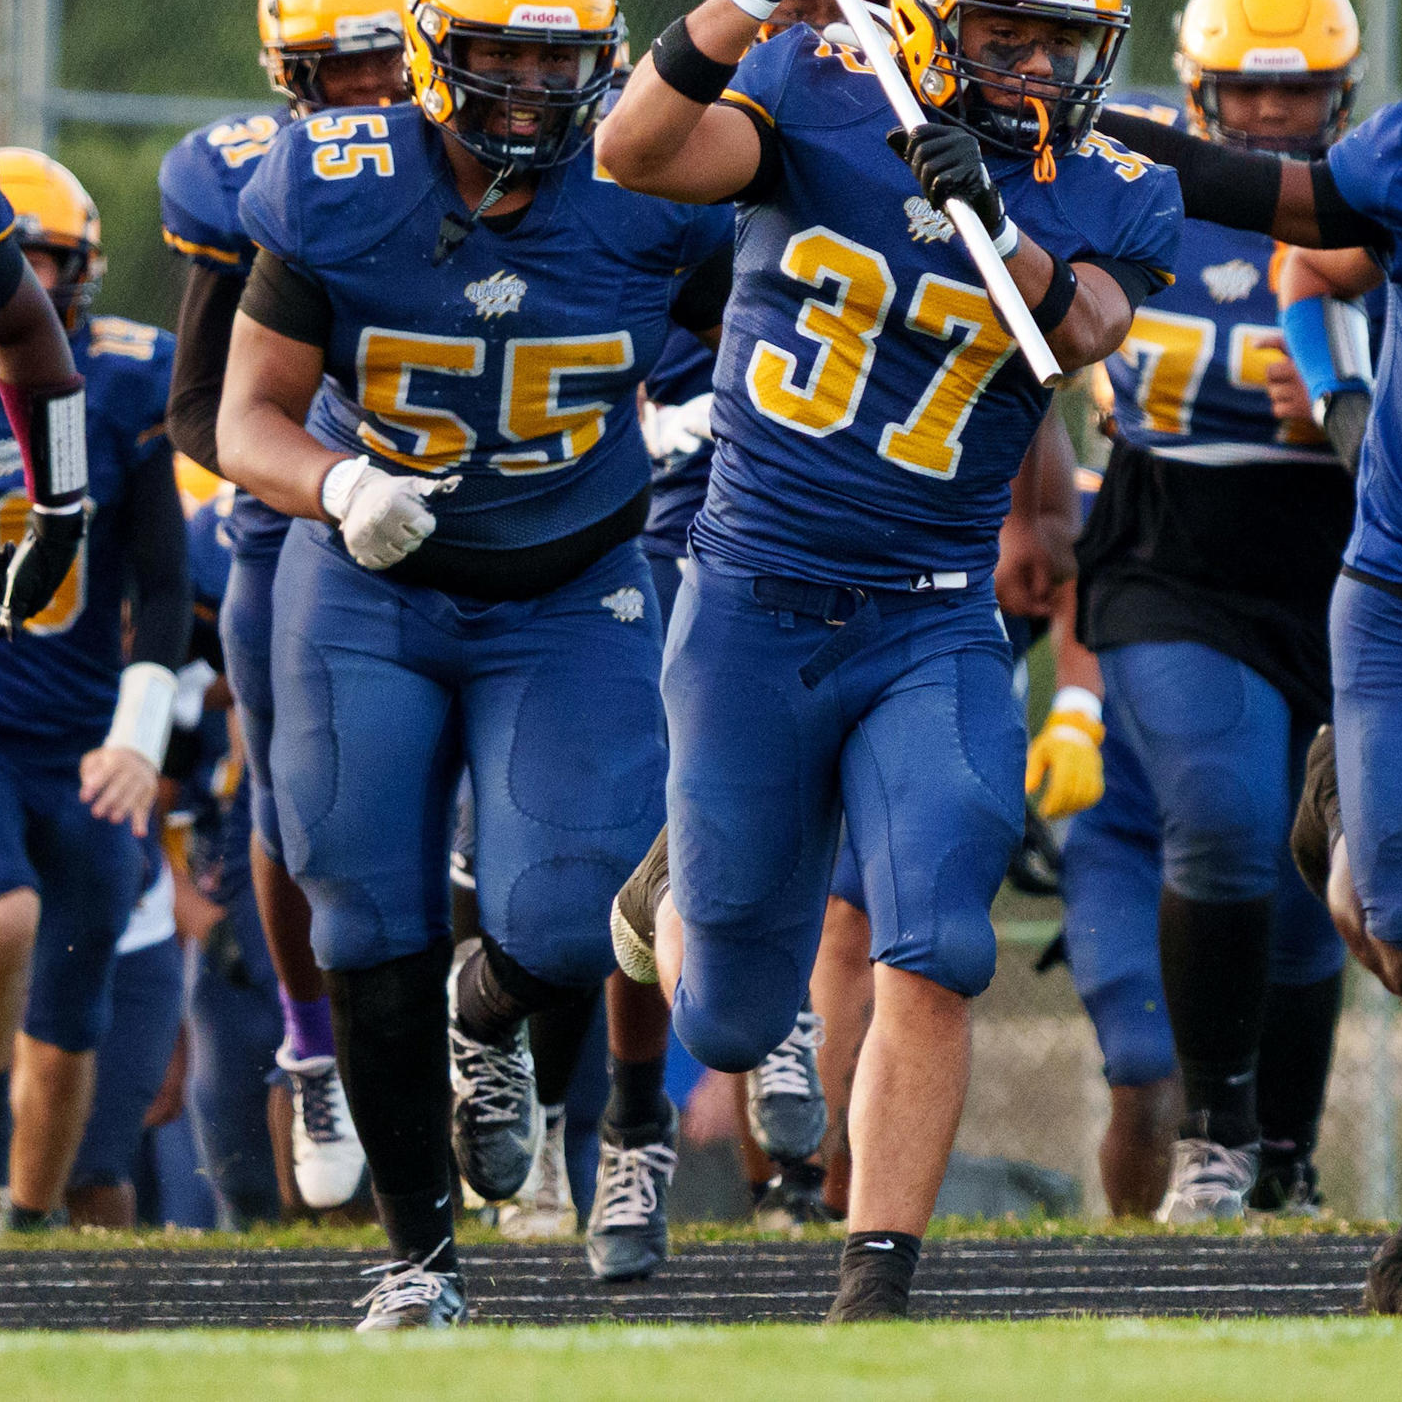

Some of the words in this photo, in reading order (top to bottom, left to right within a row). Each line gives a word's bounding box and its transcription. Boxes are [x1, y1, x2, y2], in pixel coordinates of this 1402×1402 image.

[305, 114, 395, 181] 55
[357, 327, 634, 477] 55
[746, 225, 1018, 480] 37
